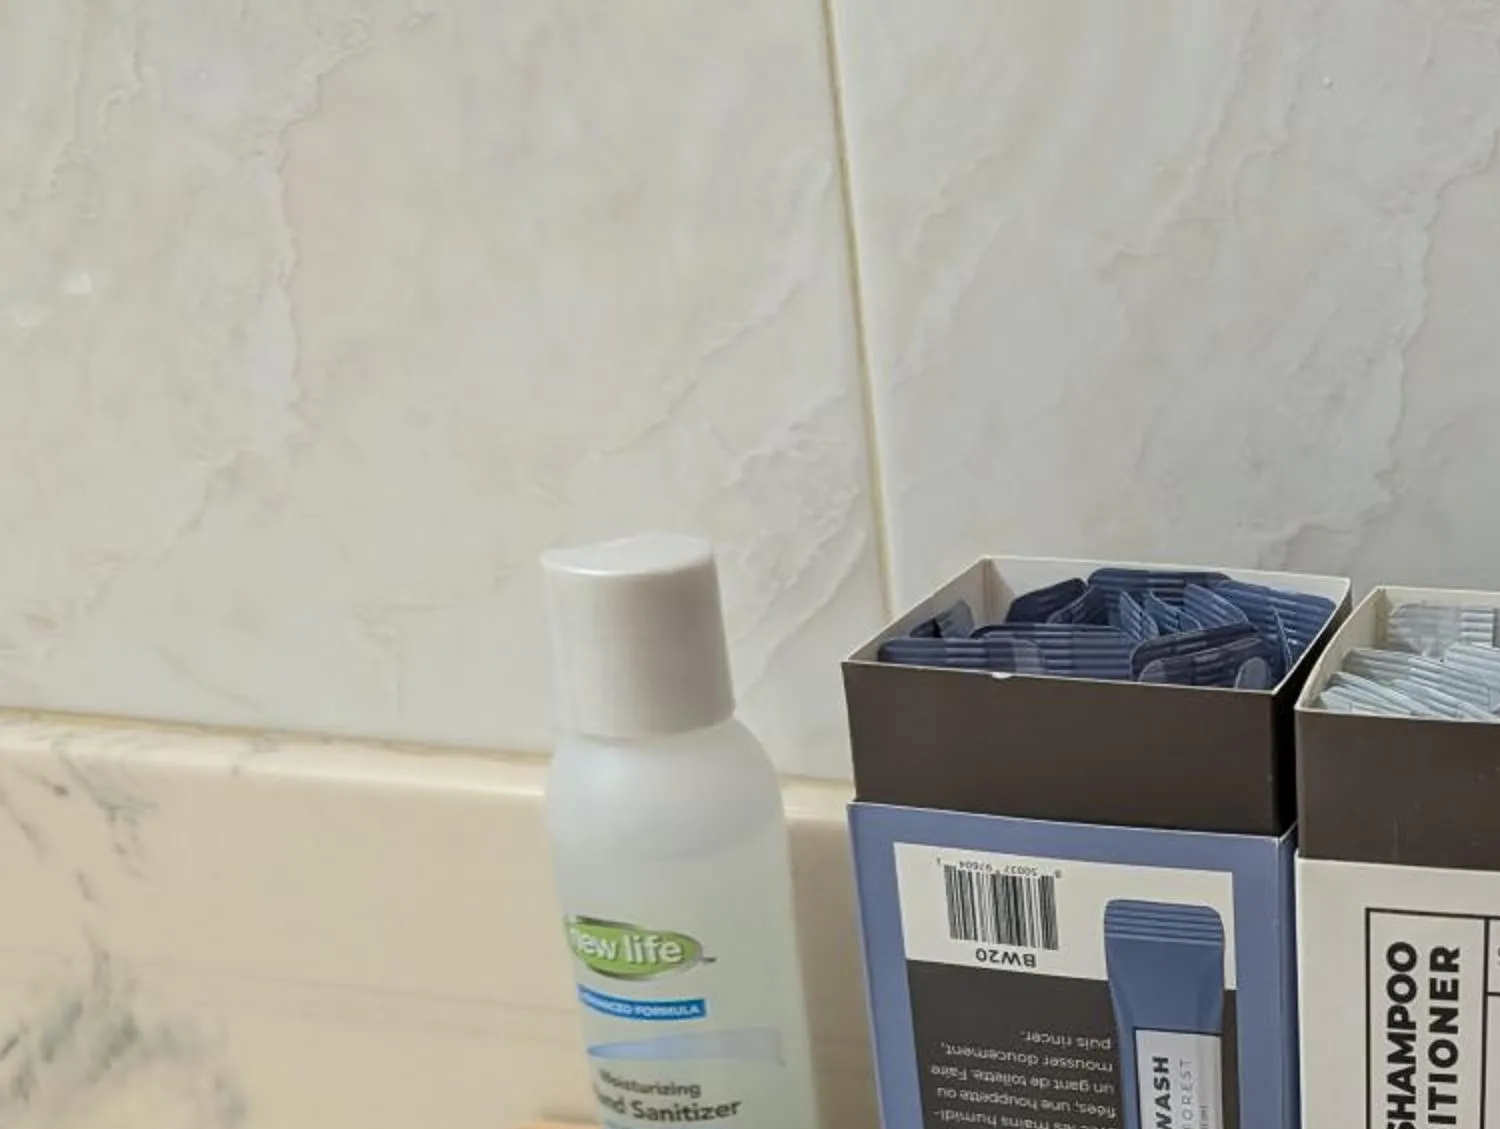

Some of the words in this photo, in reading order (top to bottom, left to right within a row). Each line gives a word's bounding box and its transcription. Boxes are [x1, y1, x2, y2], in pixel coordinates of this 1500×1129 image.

[623, 933, 684, 964] life
[975, 947, 1037, 969] BW20
[1020, 1030, 1073, 1046] rincer.
[1077, 1036, 1112, 1050] puis
[940, 1041, 1039, 1066] doucement,
[930, 1063, 968, 1081] Faire
[1041, 1055, 1114, 1073] mousser
[1028, 1077, 1051, 1089] de
[1053, 1078, 1089, 1094] gant
[1093, 1082, 1115, 1095] un
[593, 1081, 628, 1115] nd
[630, 1099, 743, 1123] Sanitizer
[936, 1087, 957, 1100] ou
[959, 1089, 1038, 1111] houppette
[1040, 1100, 1071, 1113] une
[934, 1109, 998, 1128] humidi-
